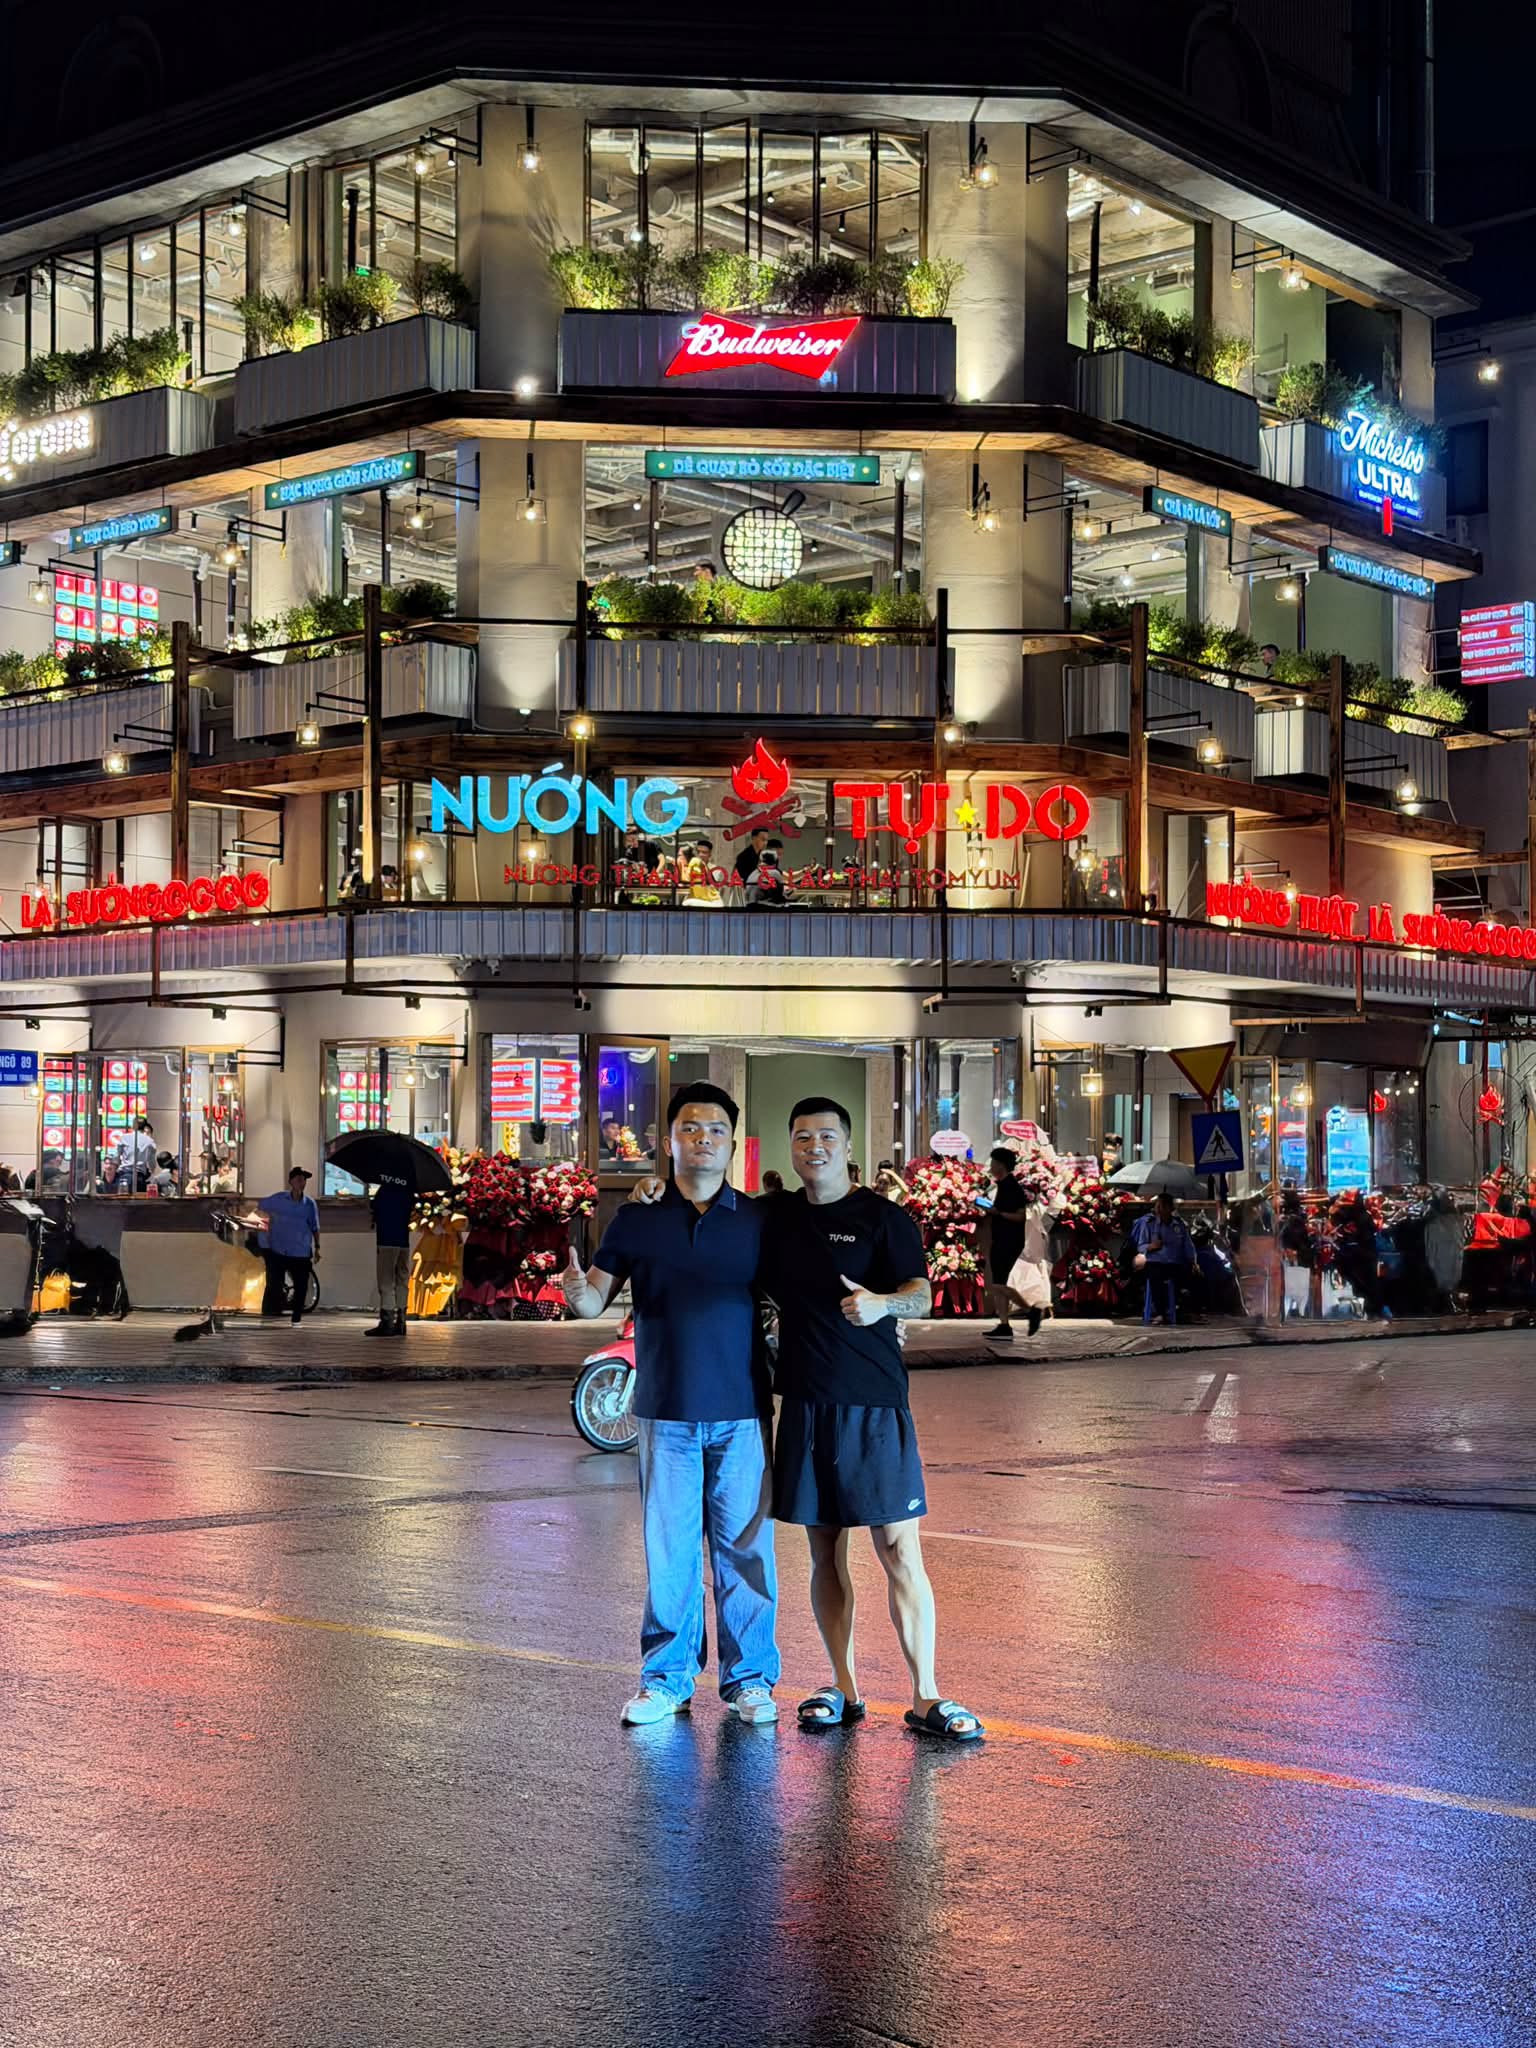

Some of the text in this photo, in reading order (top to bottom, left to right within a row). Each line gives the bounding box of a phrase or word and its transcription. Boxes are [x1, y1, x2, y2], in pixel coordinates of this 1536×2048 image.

[682, 322, 842, 356] Budweiser
[1341, 410, 1425, 474] Michelob
[431, 761, 689, 836] NƯỚNG
[833, 782, 1091, 856] TỰ DO
[757, 864, 777, 890] &
[912, 868, 1021, 892] TOMYUM
[1369, 901, 1397, 943] LÀ
[21, 1055, 32, 1069] 89
